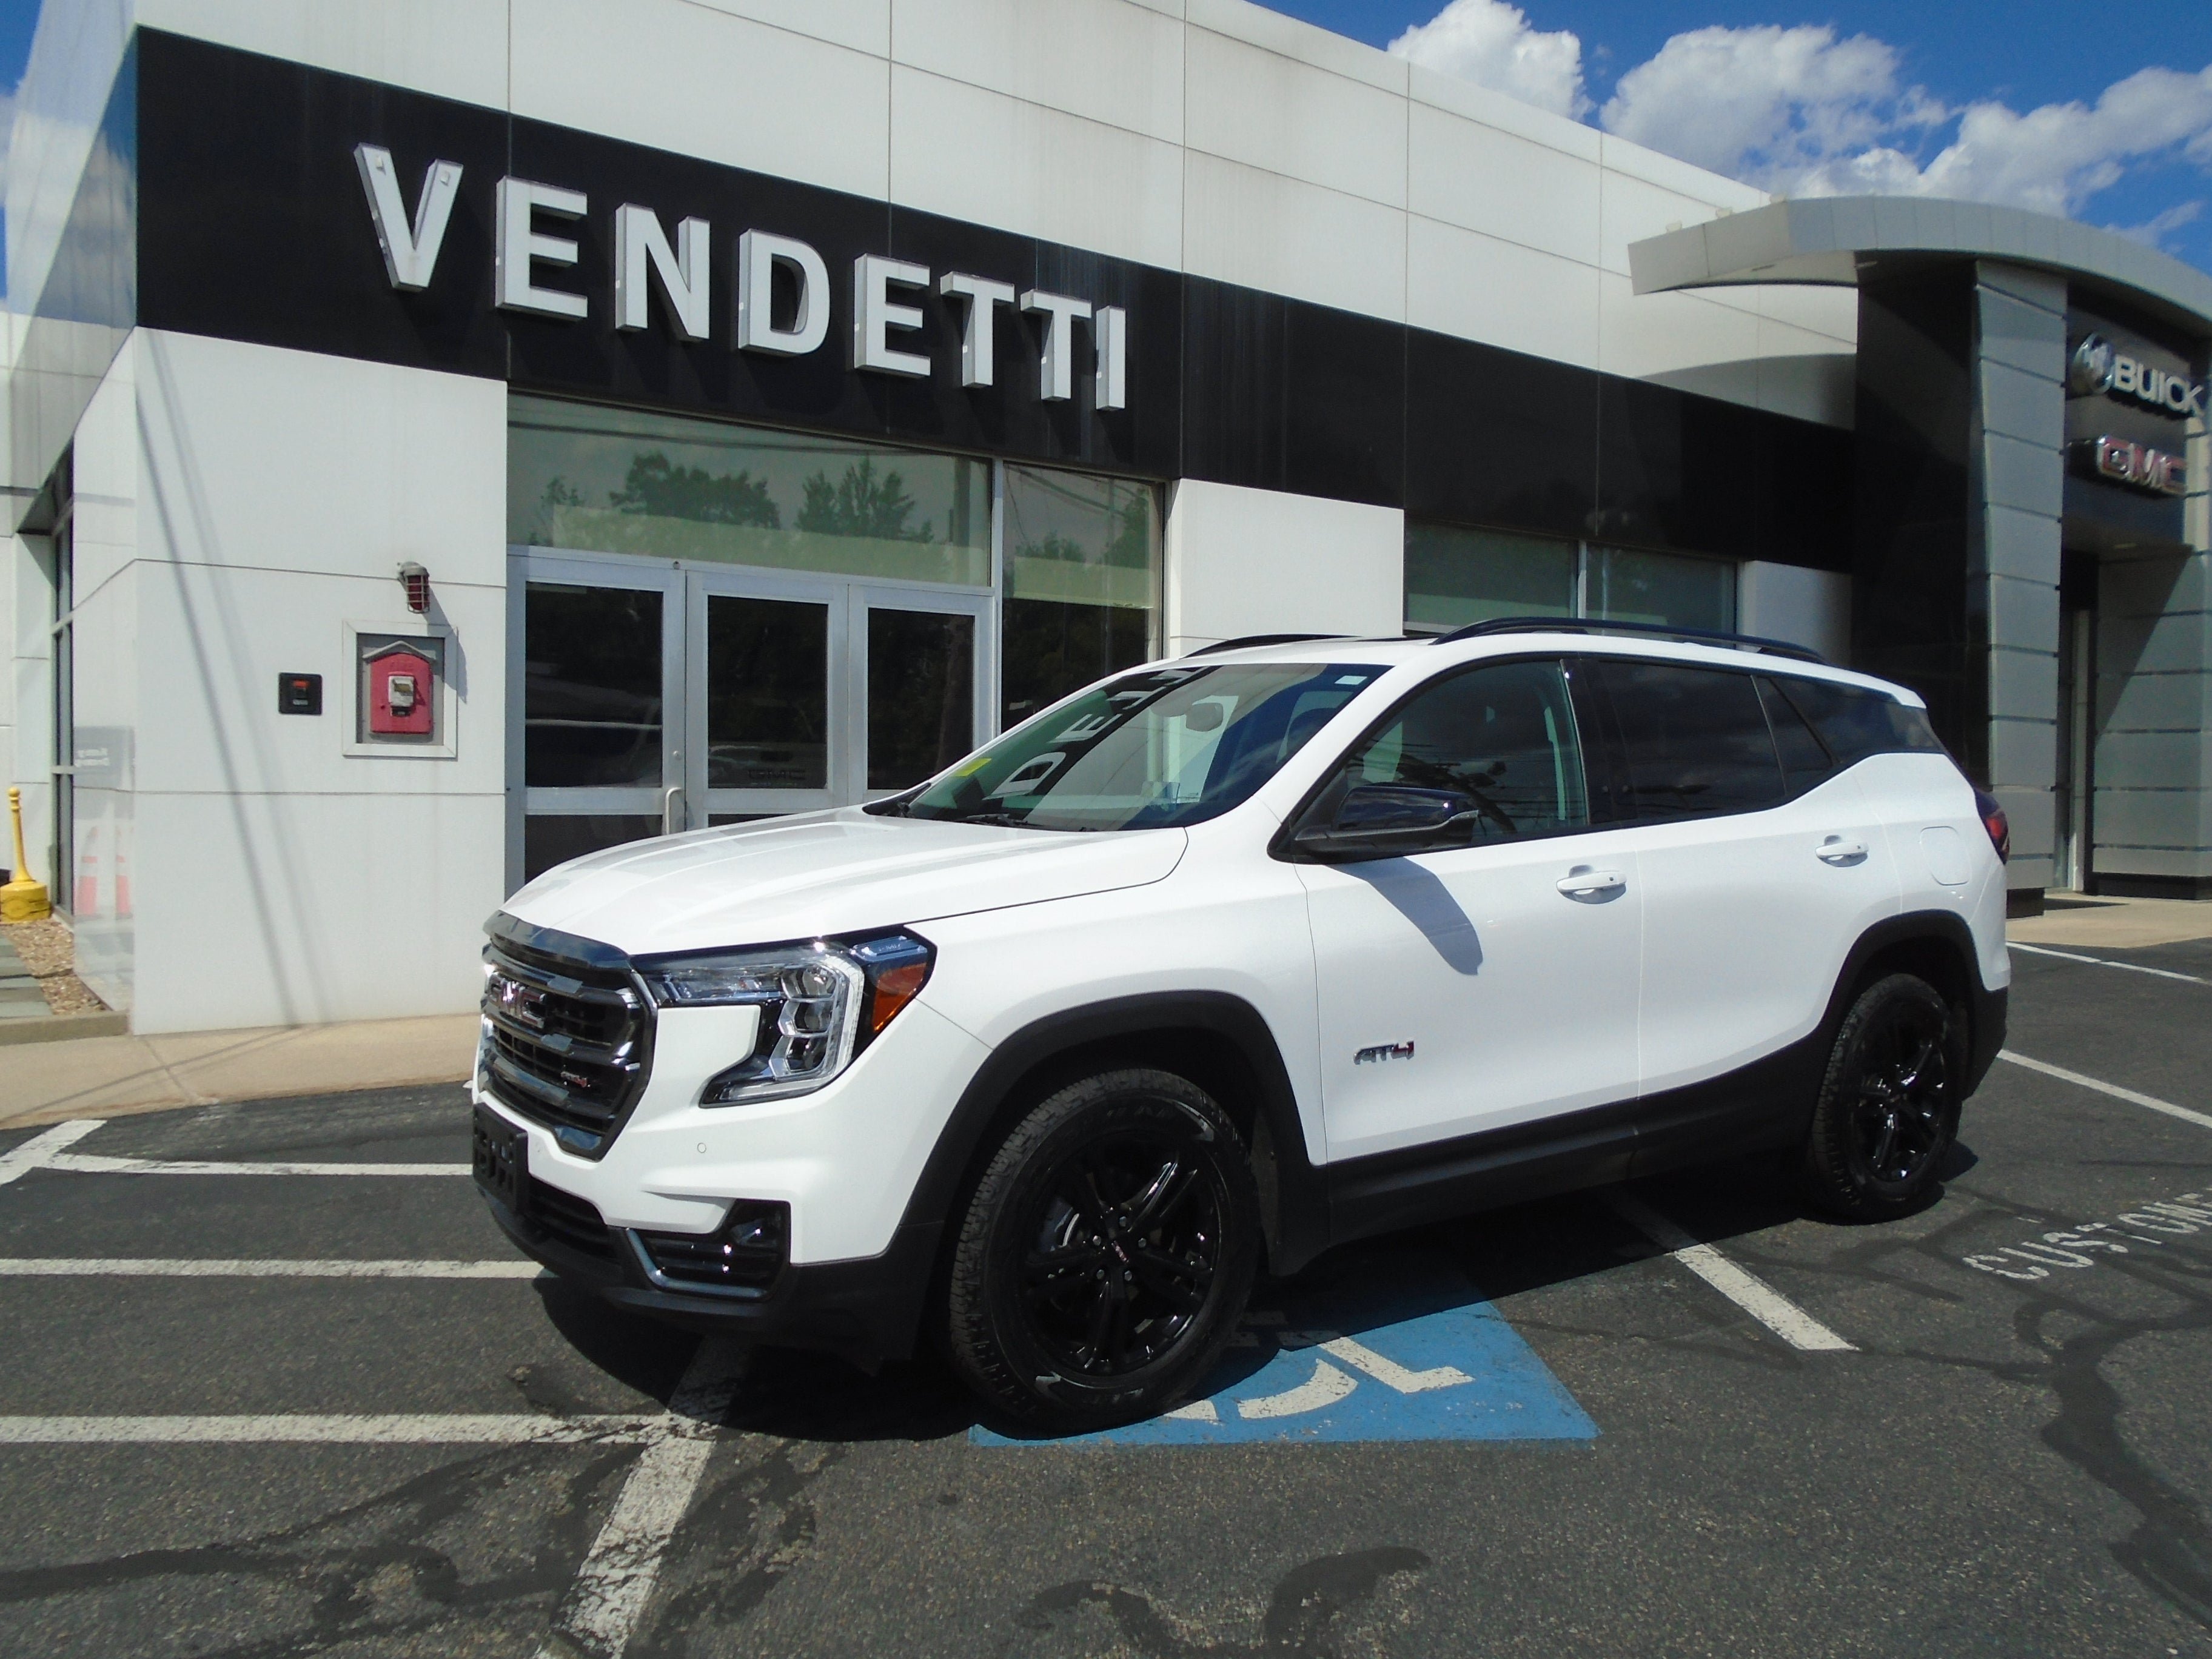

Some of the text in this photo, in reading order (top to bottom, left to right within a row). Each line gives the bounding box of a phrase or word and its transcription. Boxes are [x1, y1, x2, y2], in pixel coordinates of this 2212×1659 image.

[353, 142, 1127, 412] VENDETTI
[2114, 355, 2204, 418] BUICK
[1354, 1041, 1415, 1065] AT4
